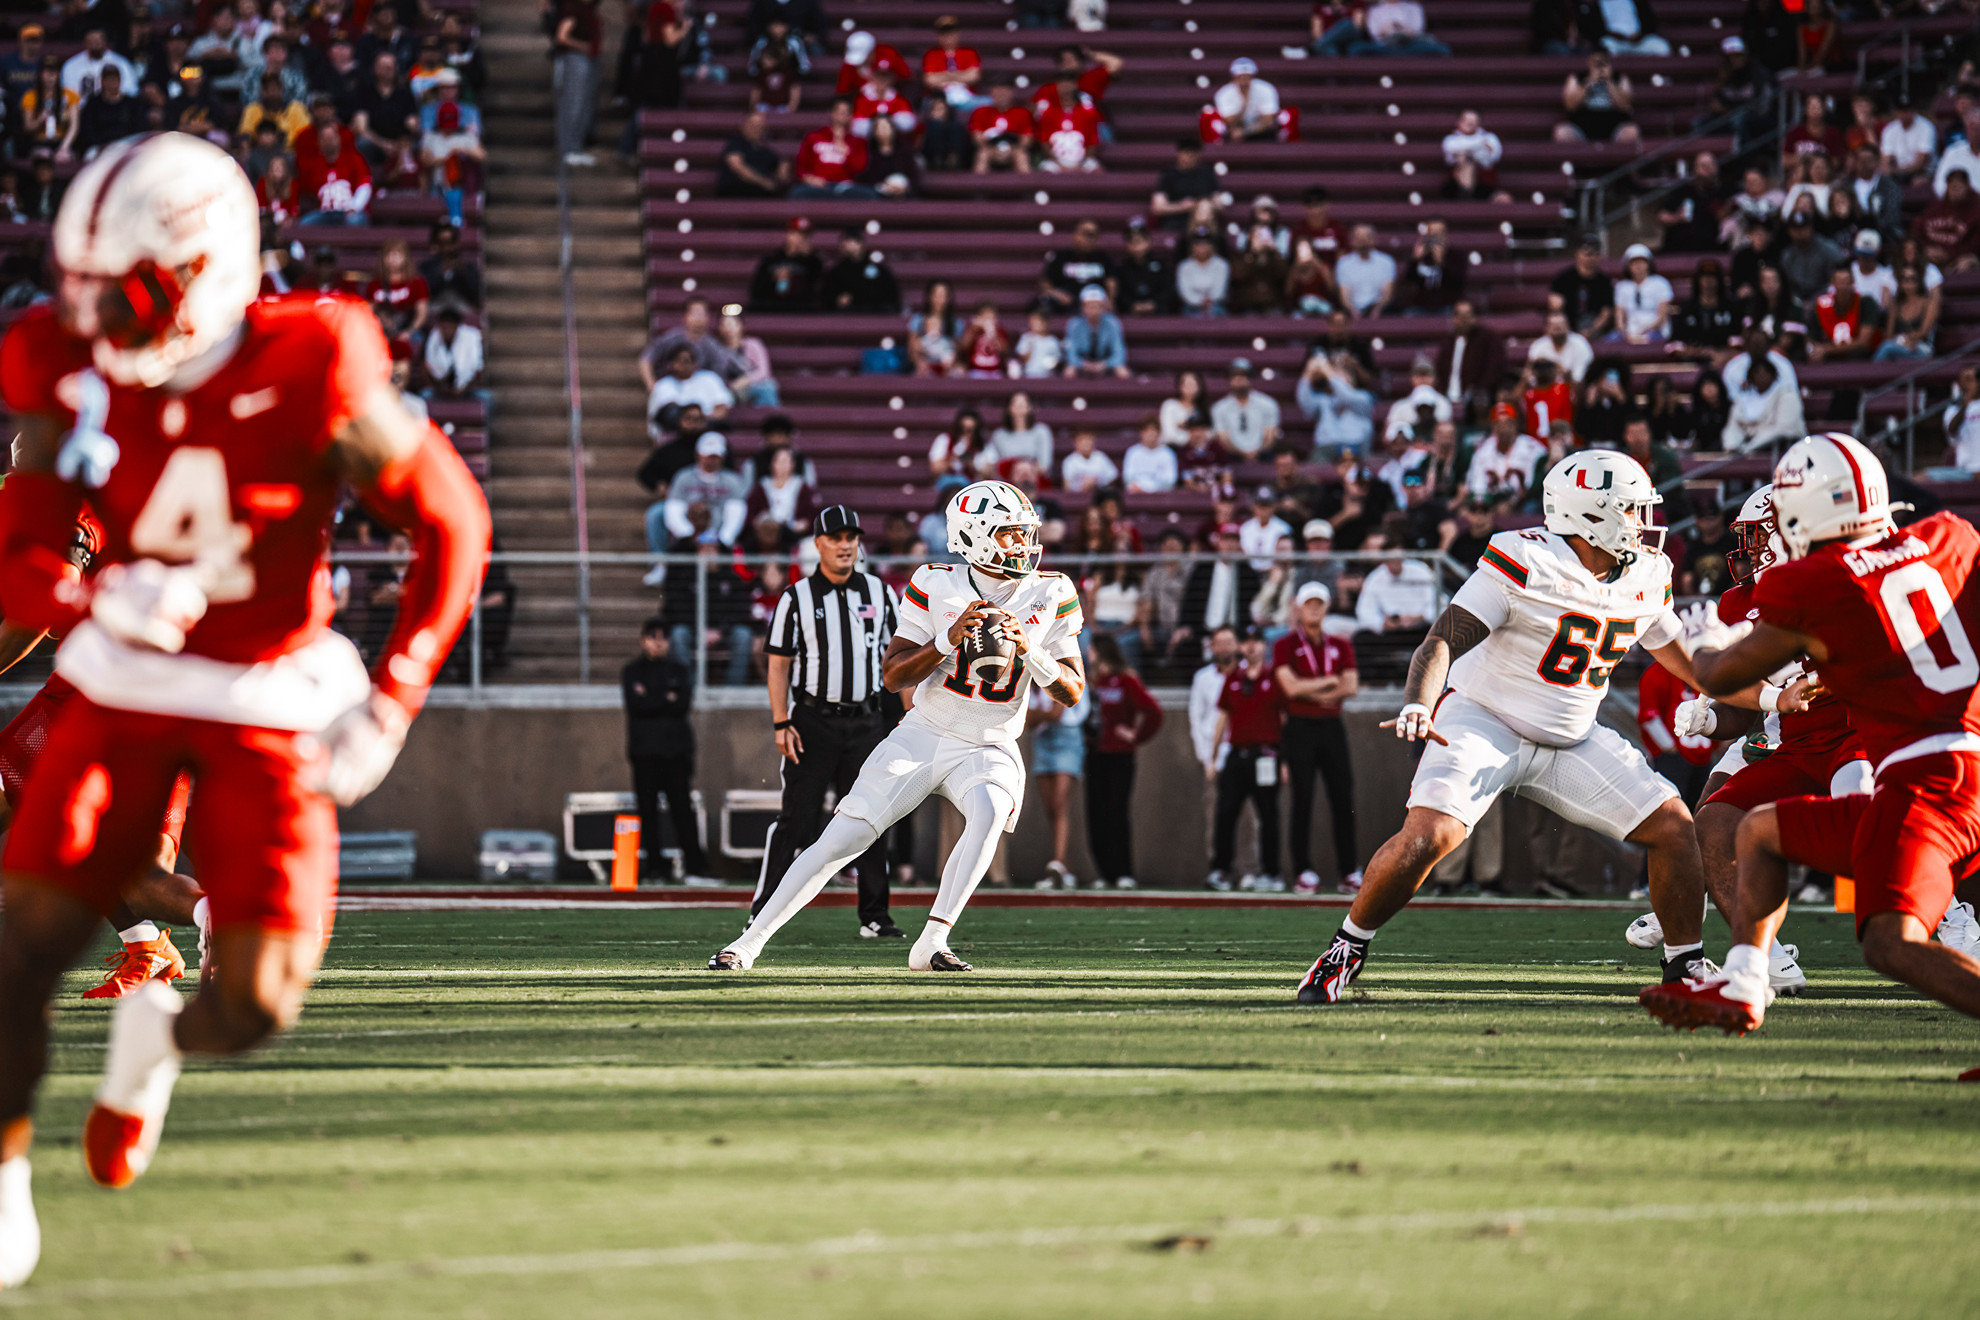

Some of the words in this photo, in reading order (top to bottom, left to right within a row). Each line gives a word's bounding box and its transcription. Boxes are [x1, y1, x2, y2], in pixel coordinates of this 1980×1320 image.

[959, 496, 989, 514] U
[1576, 469, 1613, 490] U
[131, 446, 257, 604] 4
[815, 607, 825, 620] S
[1879, 560, 1980, 694] 0
[943, 645, 1026, 703] 10
[1537, 611, 1638, 690] 65
